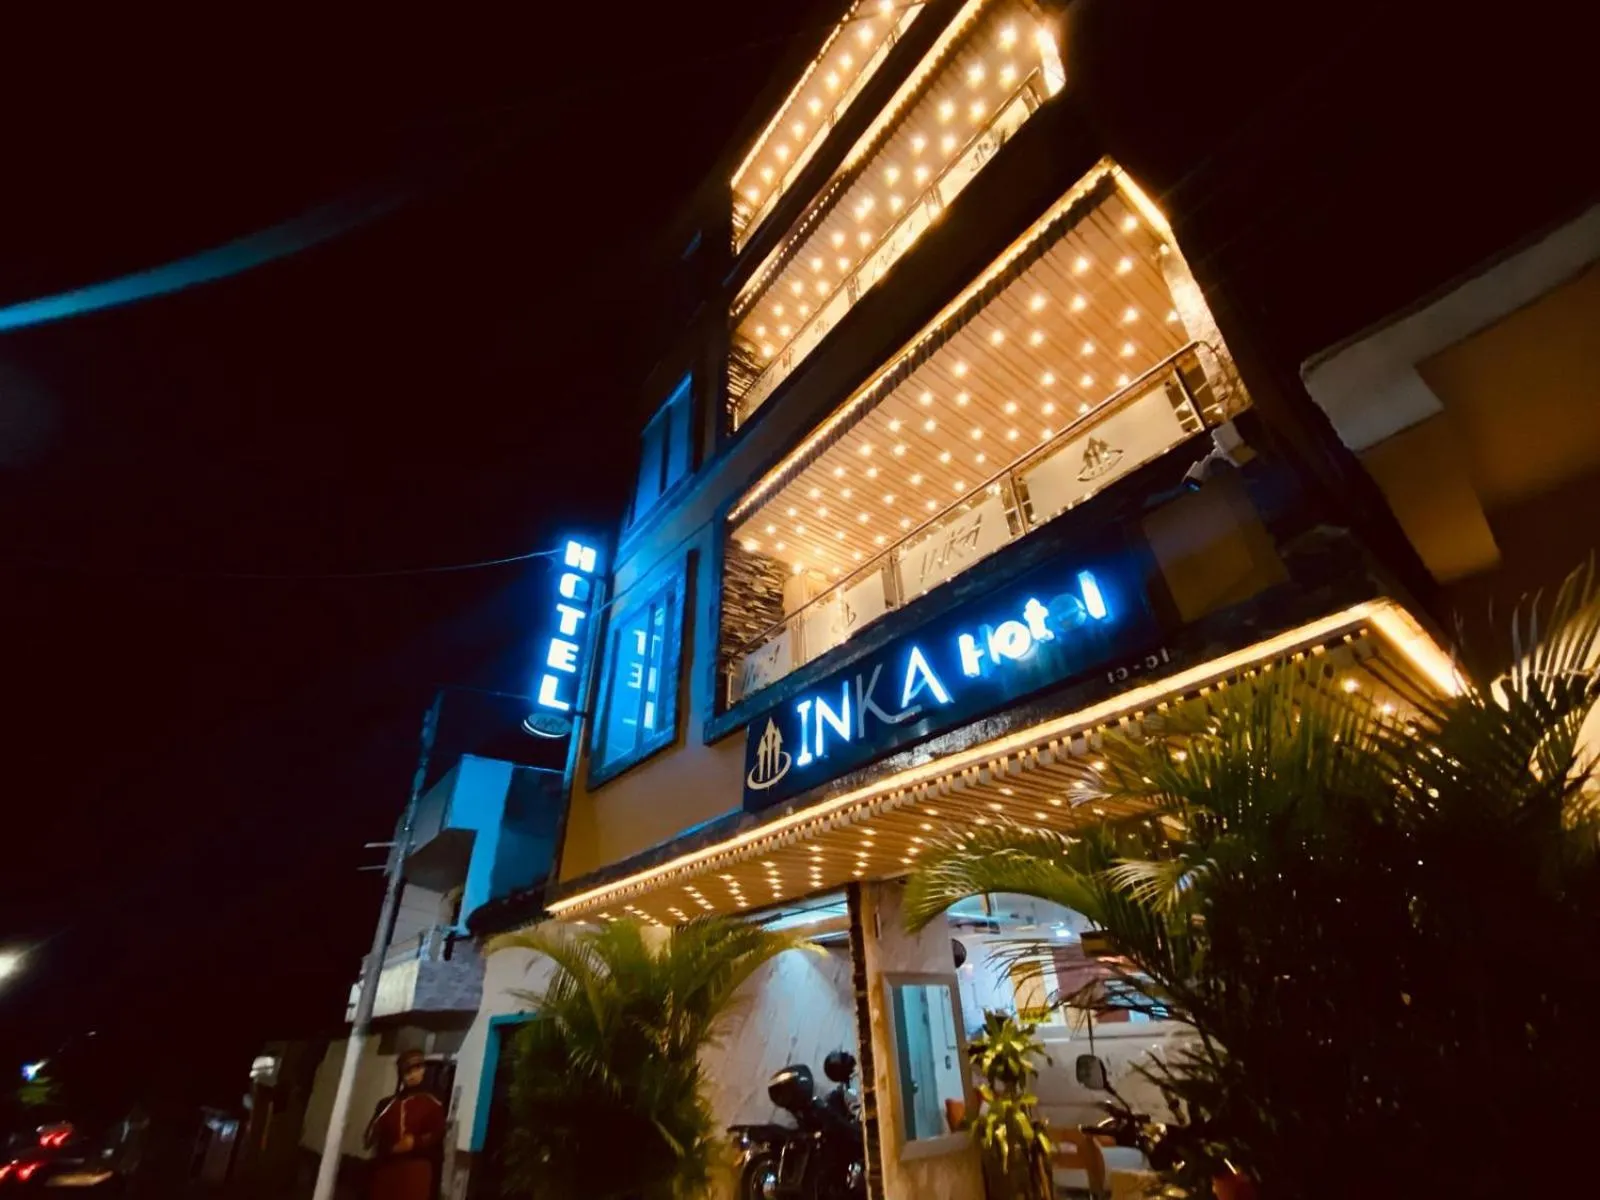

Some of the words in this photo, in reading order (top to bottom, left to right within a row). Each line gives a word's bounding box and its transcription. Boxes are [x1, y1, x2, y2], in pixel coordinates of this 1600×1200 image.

[537, 540, 597, 711] HOTEL
[796, 646, 955, 767] INKA
[958, 570, 1113, 679] Hotel
